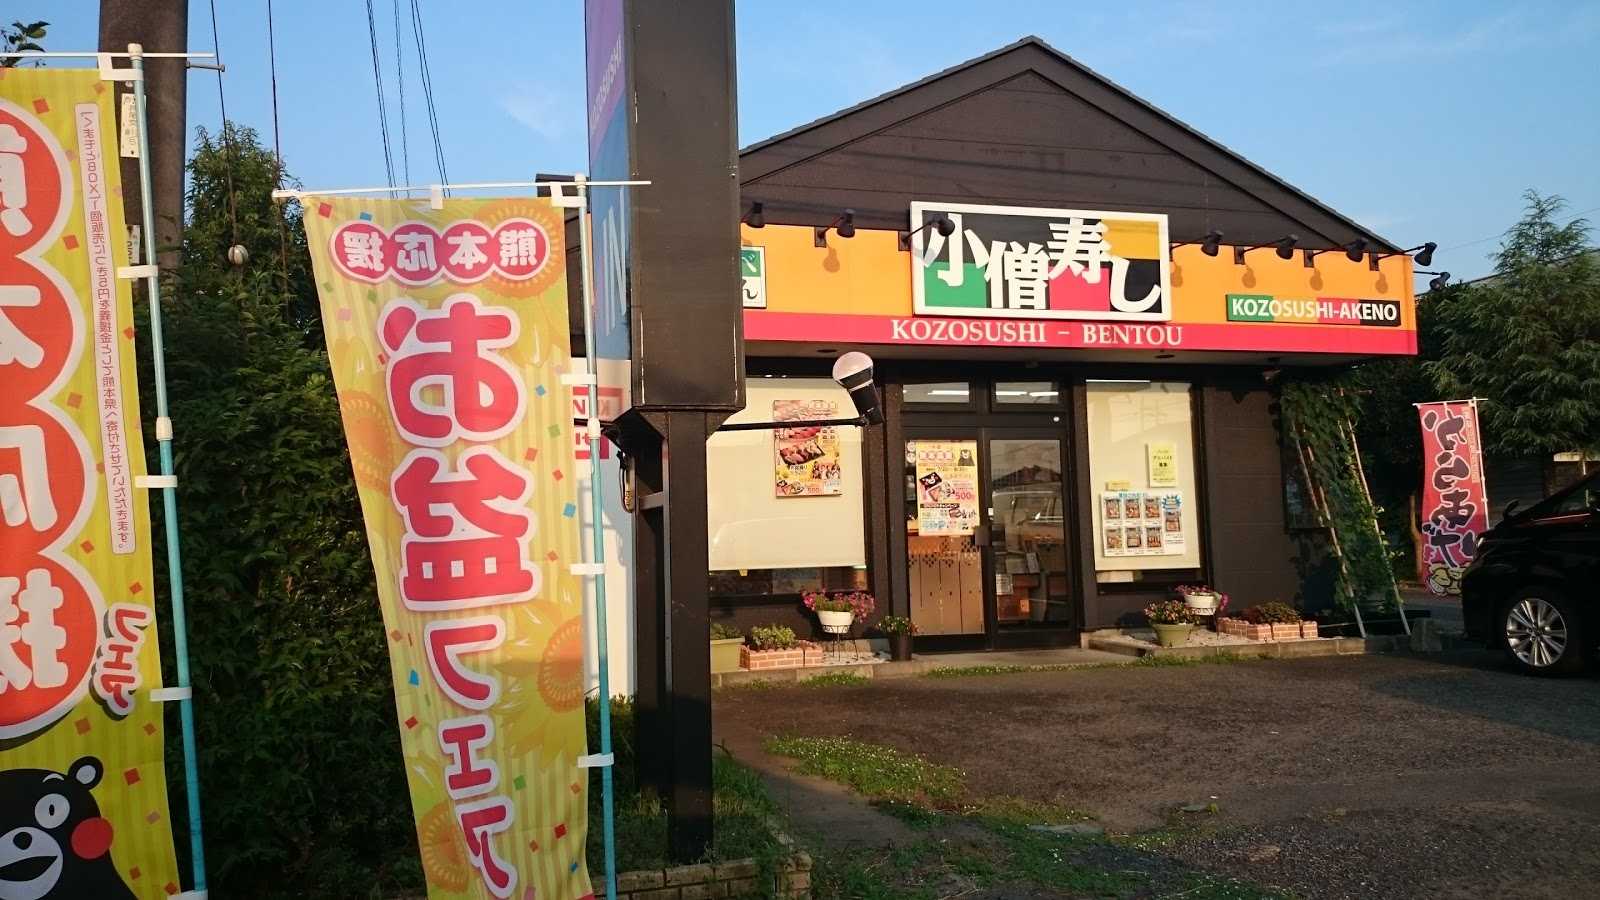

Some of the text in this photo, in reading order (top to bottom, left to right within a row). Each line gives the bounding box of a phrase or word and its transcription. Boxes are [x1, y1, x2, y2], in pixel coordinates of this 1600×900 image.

[923, 213, 1161, 313] 小僧寿し
[1232, 298, 1397, 321] KOZOSUSHI-AKENO
[891, 319, 1047, 343] KOZOSUSHI
[1081, 323, 1184, 345] BENTOU
